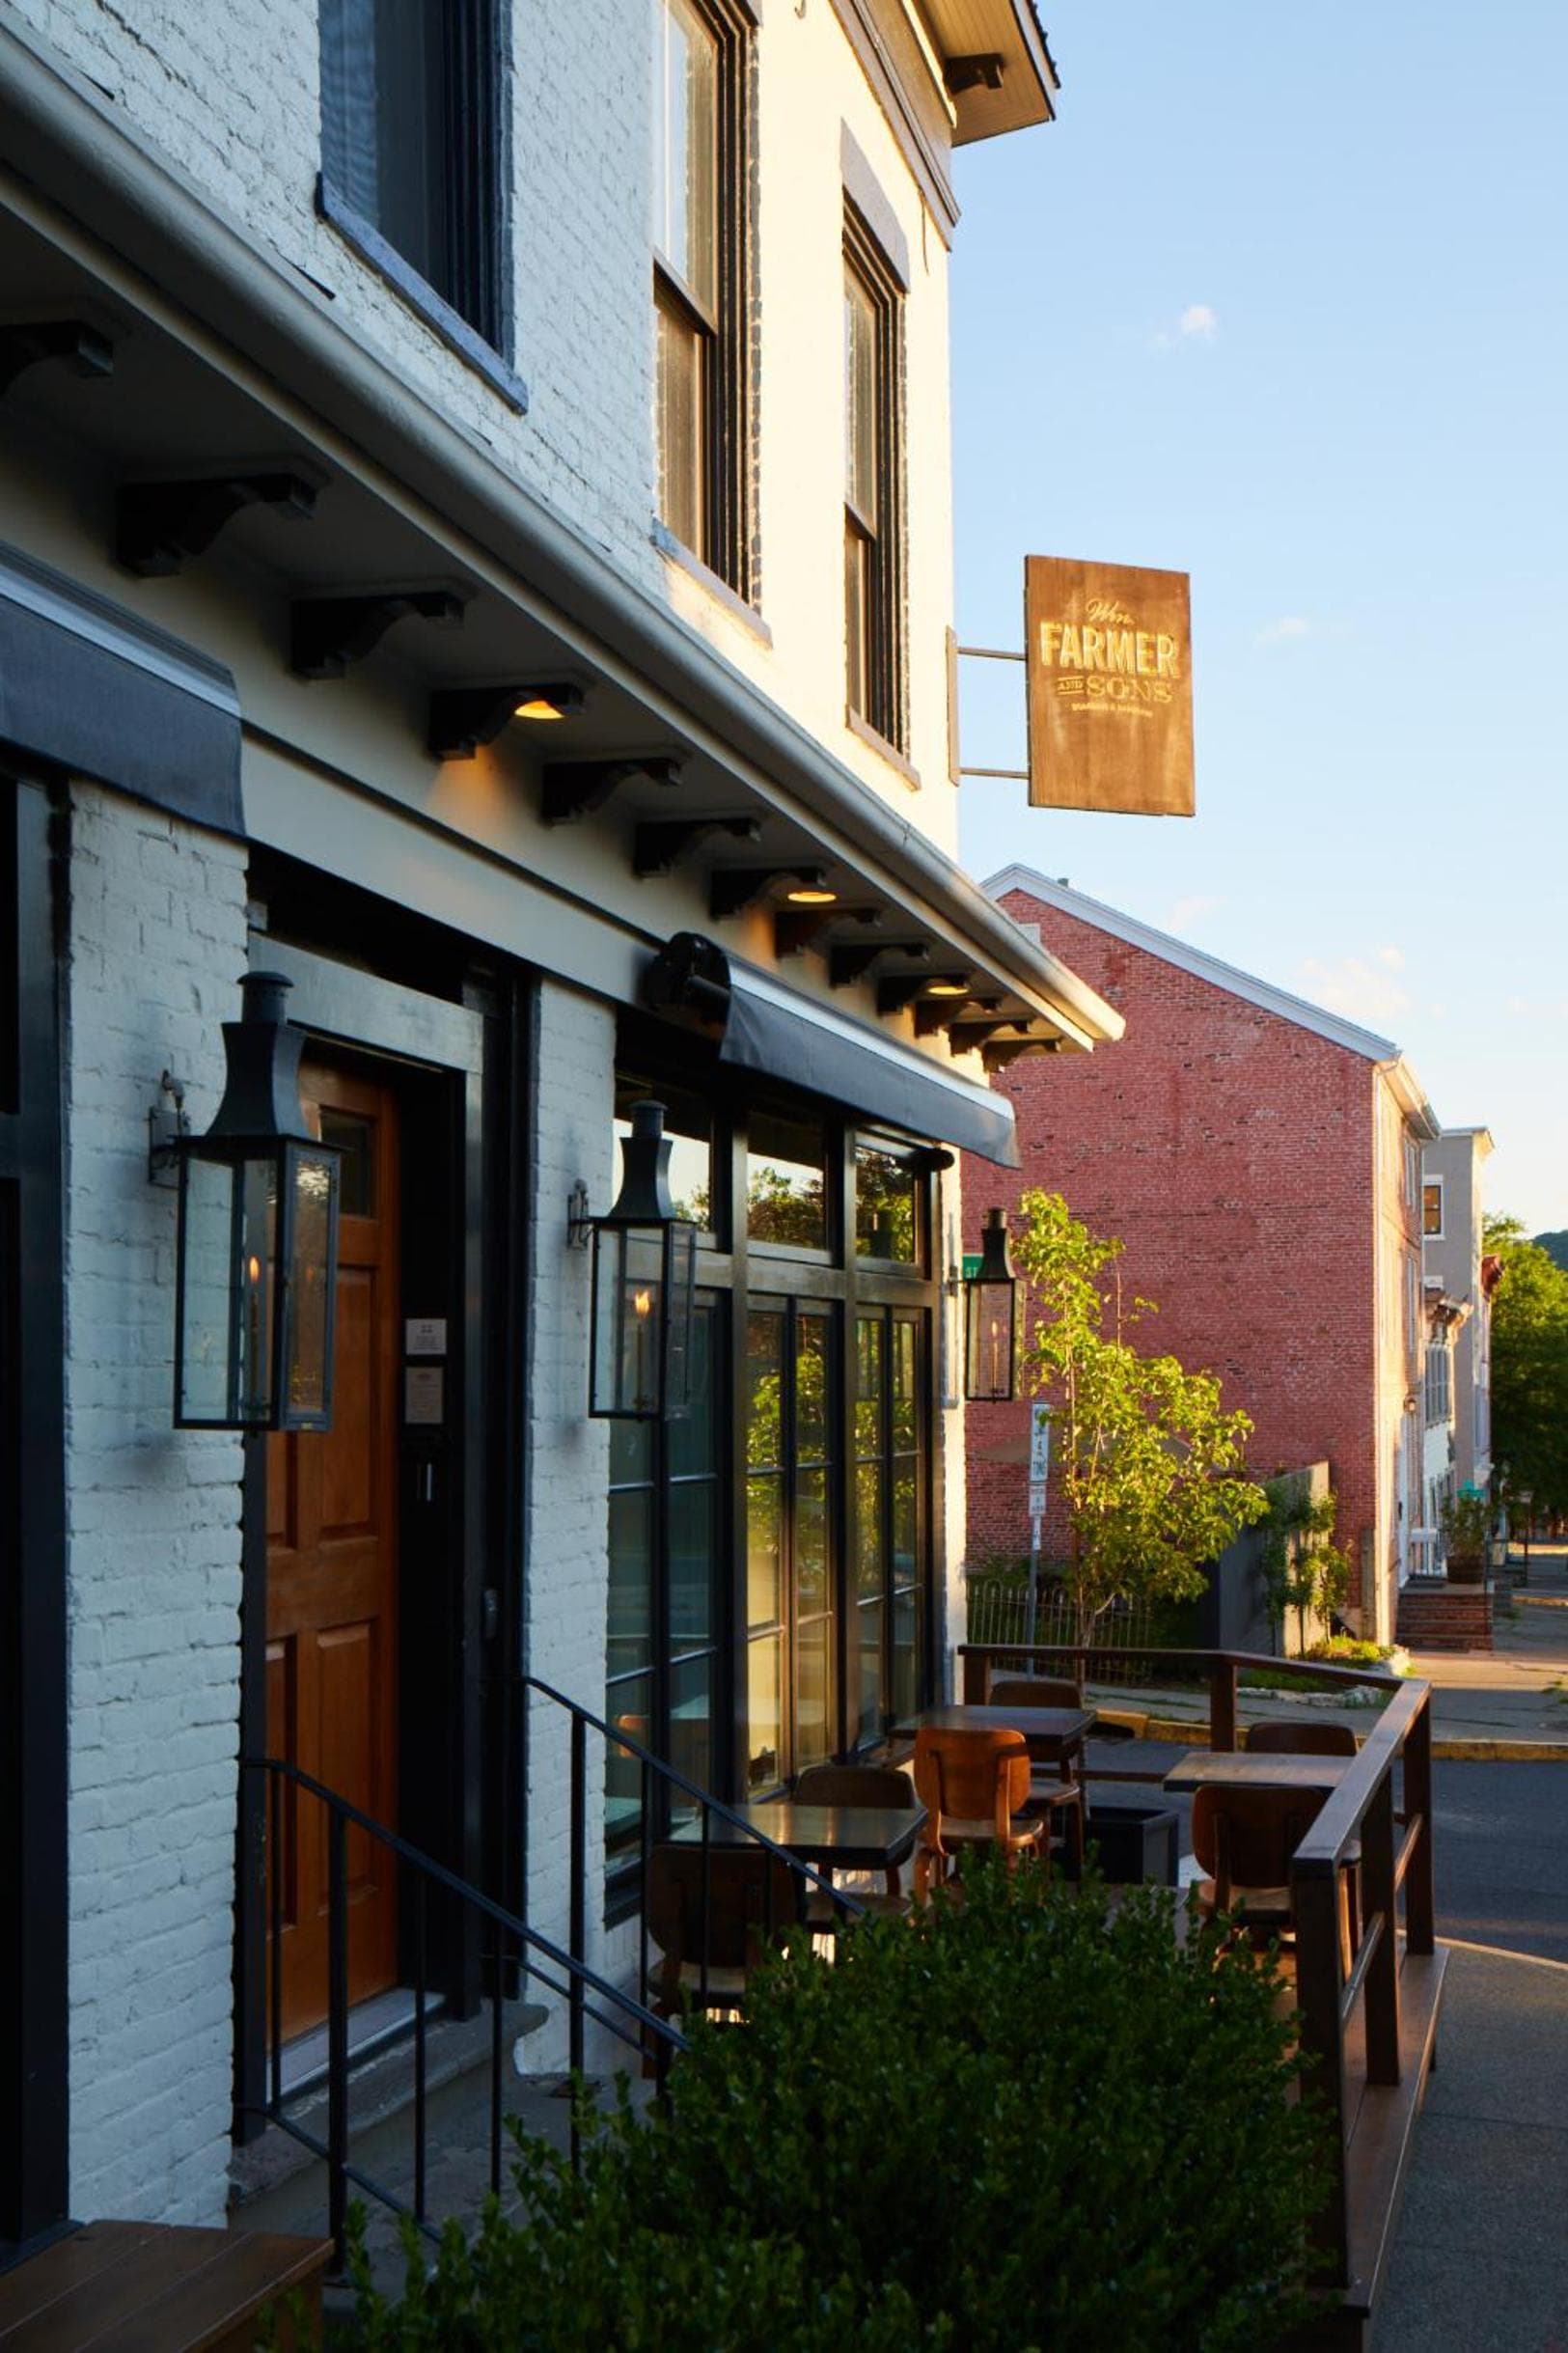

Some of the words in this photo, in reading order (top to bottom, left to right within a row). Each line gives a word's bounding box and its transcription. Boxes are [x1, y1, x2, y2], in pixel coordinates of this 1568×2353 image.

[1040, 622, 1179, 679] FARMER
[1059, 678, 1083, 691] AND
[1087, 676, 1173, 703] SONS
